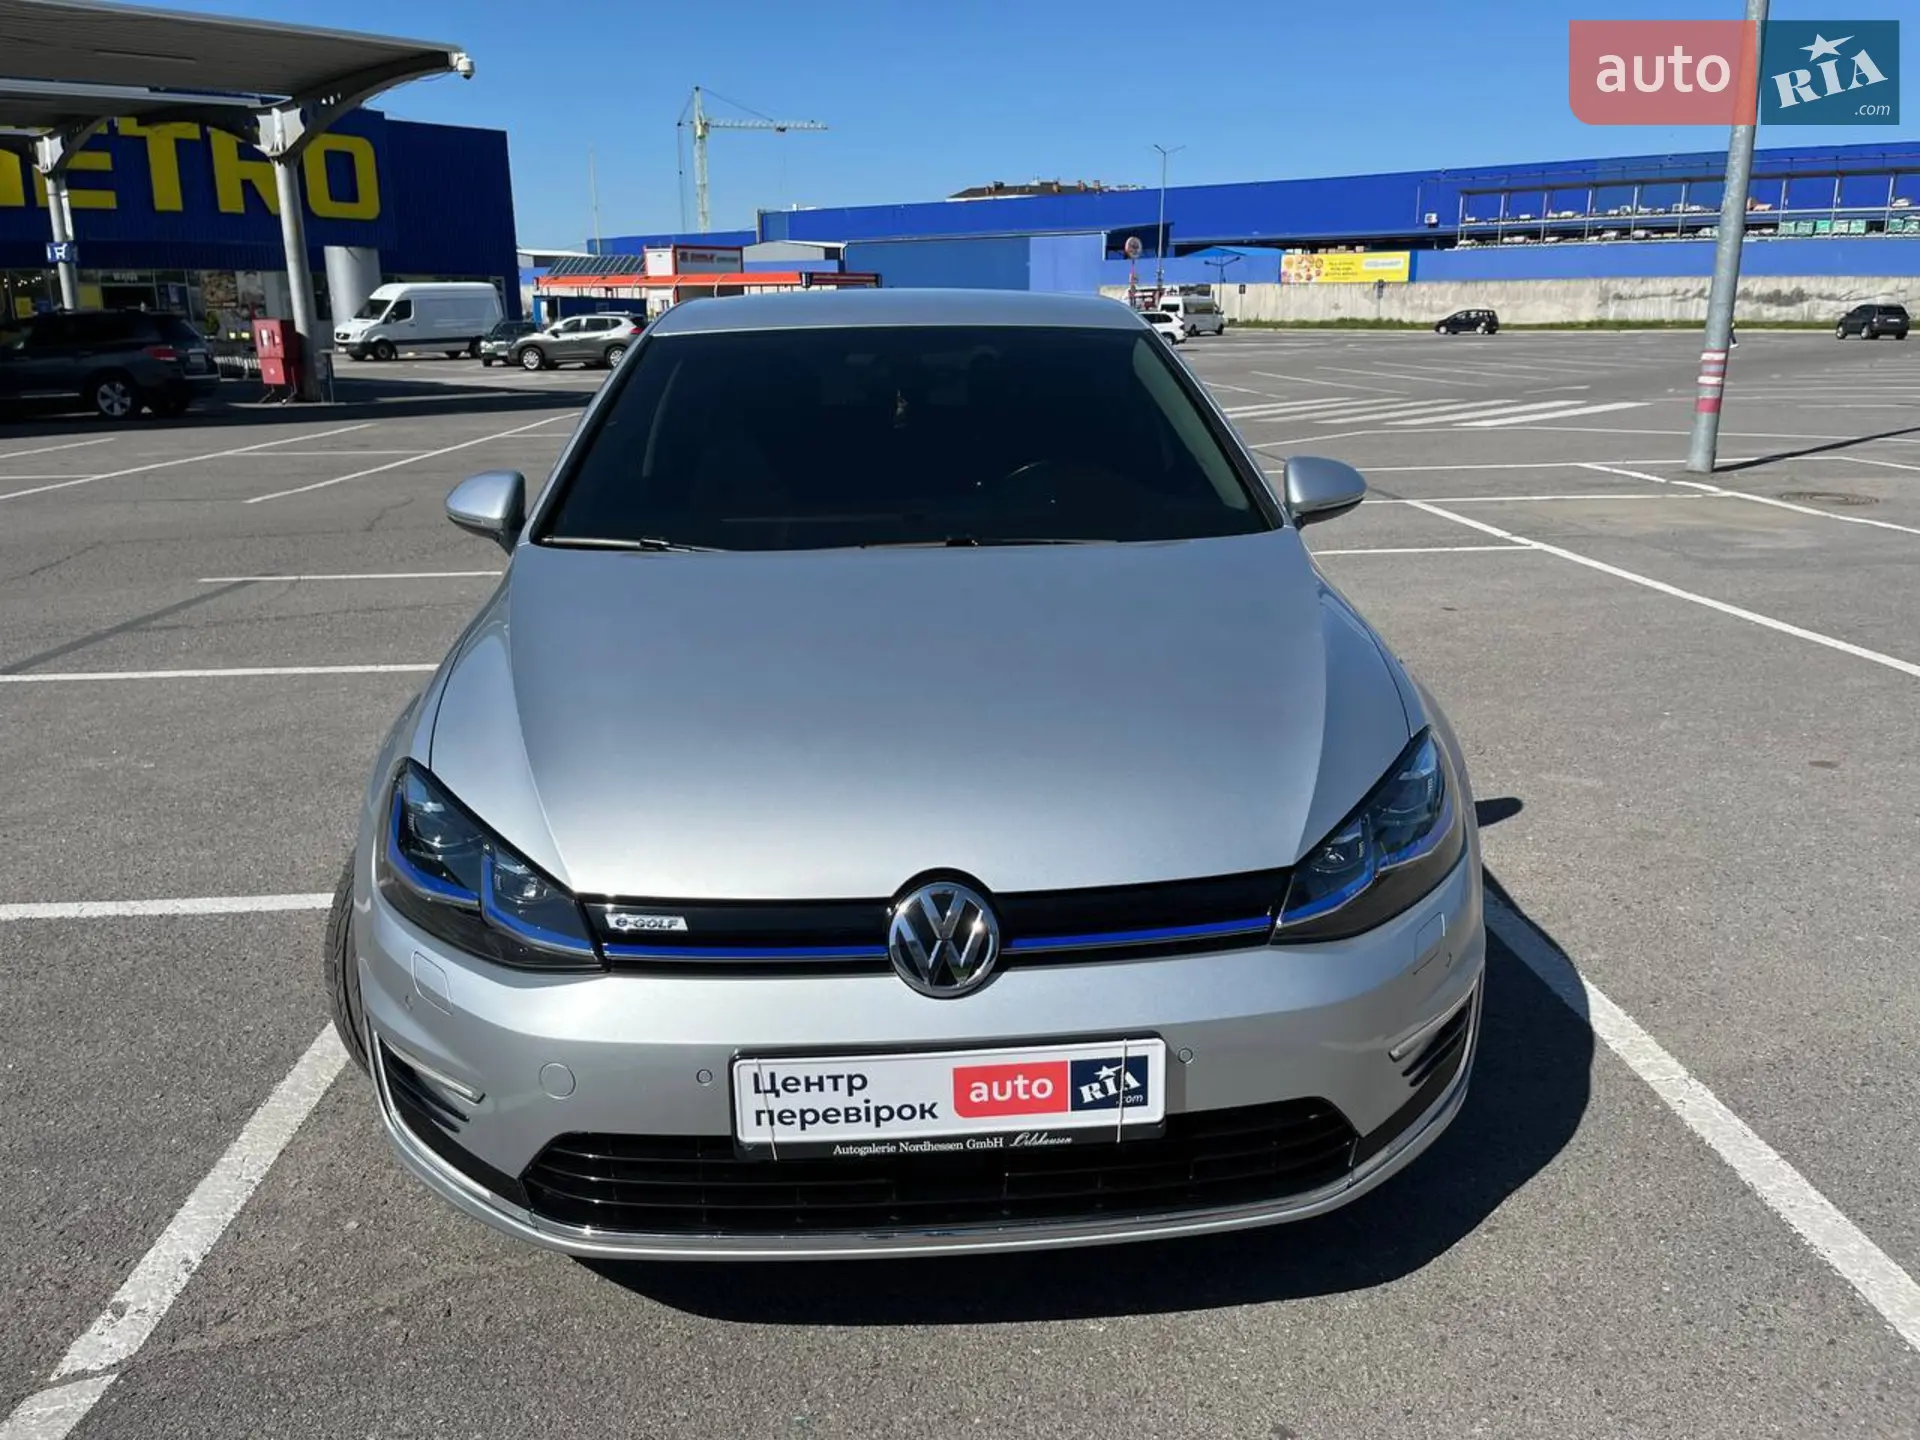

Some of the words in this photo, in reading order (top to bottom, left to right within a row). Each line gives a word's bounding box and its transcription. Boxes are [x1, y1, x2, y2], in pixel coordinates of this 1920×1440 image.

[0, 116, 381, 220] ETRO
[753, 1072, 868, 1098] Центр
[970, 1075, 1053, 1104] auto
[1079, 1071, 1141, 1103] RIA
[755, 1099, 939, 1131] перевірок
[833, 1143, 896, 1156] Autogalerie
[899, 1141, 964, 1153] Nordhessen
[966, 1137, 1004, 1150] GmbH
